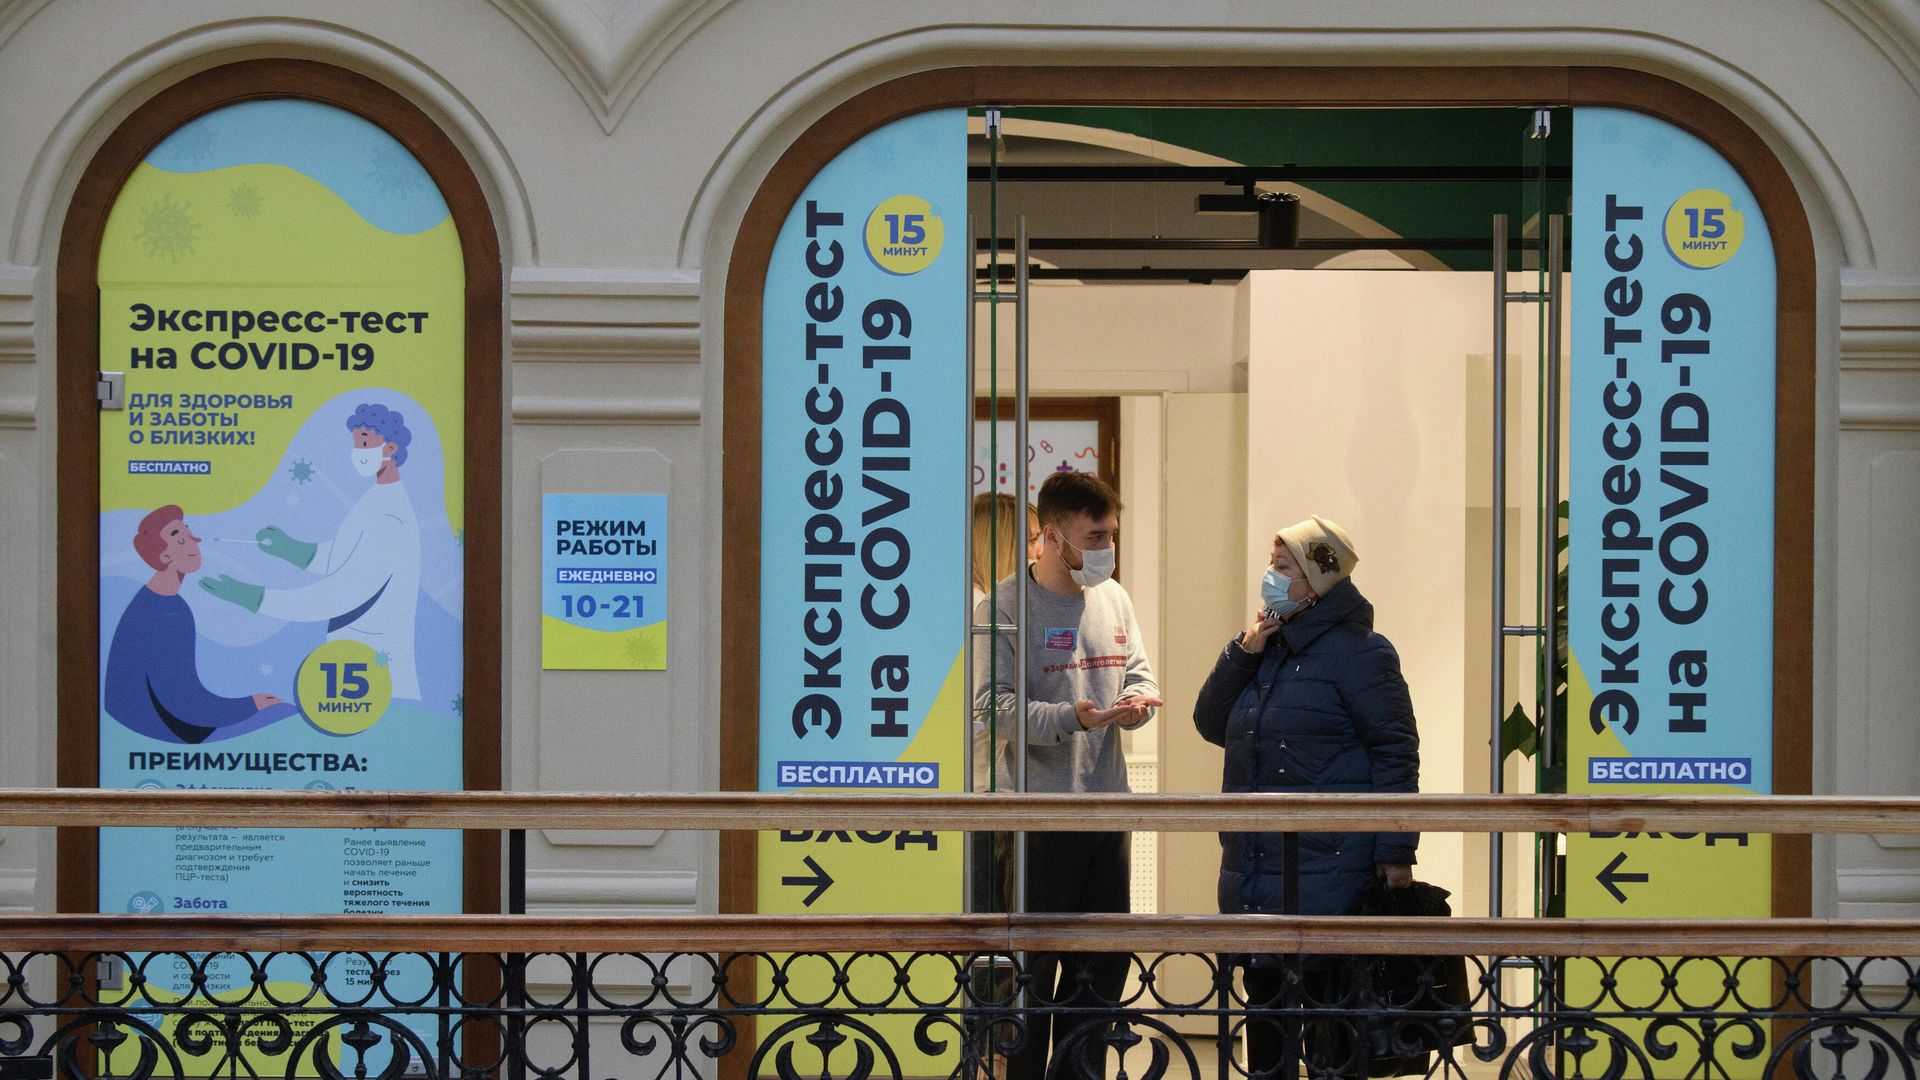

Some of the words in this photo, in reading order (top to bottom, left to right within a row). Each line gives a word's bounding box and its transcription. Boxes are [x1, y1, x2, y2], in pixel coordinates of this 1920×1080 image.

[885, 214, 926, 245] 15
[1684, 208, 1726, 239] 15
[883, 247, 928, 256] МИНУТ
[1682, 240, 1727, 250] МИНУТ
[129, 303, 429, 339] Экспресс-тест
[130, 347, 178, 369] на
[190, 342, 375, 371] COVID-19
[129, 393, 172, 409] ДЛЯ
[179, 394, 293, 410] ЗДОРОВЬЯ
[130, 412, 143, 426] И
[150, 412, 238, 427] ЗАБОТЫ
[129, 430, 145, 444] О
[151, 430, 256, 446] БЛИЗКИХ!
[861, 298, 912, 630] COVID-19
[1589, 194, 1653, 736] Экспресс-тест
[1658, 293, 1711, 625] COVID-19
[130, 462, 209, 473] БЕСПЛАТНО
[792, 200, 855, 740] Экспресс-тест
[556, 520, 646, 536] РЕЖИМ
[556, 539, 657, 556] РАБОТЫ
[559, 571, 656, 583] ЕЖЕДНЕВНО
[562, 595, 644, 618] 10-21
[320, 663, 369, 699] 15
[871, 655, 909, 738] на
[1668, 650, 1707, 733] на
[318, 702, 372, 713] МИНУТ
[129, 751, 369, 774] ПРЕИМУЩЕСТВА:
[1592, 762, 1747, 779] БЕСПЛАТНО
[781, 765, 935, 784] БЕСПЛАТНО
[175, 834, 229, 842] результата
[344, 838, 372, 846] Ранее
[375, 839, 426, 847] выявление
[175, 844, 262, 852] предварительным
[344, 848, 390, 856] COVID-19
[175, 854, 227, 862] диагнозом
[238, 853, 275, 863] требует
[344, 859, 392, 867] позволяет
[175, 864, 250, 872] подтверждения
[175, 873, 229, 882] ПЦР-теста)
[344, 890, 404, 898] вероятность
[174, 897, 228, 909] Забота
[173, 983, 191, 991] для
[345, 977, 354, 986] 15
